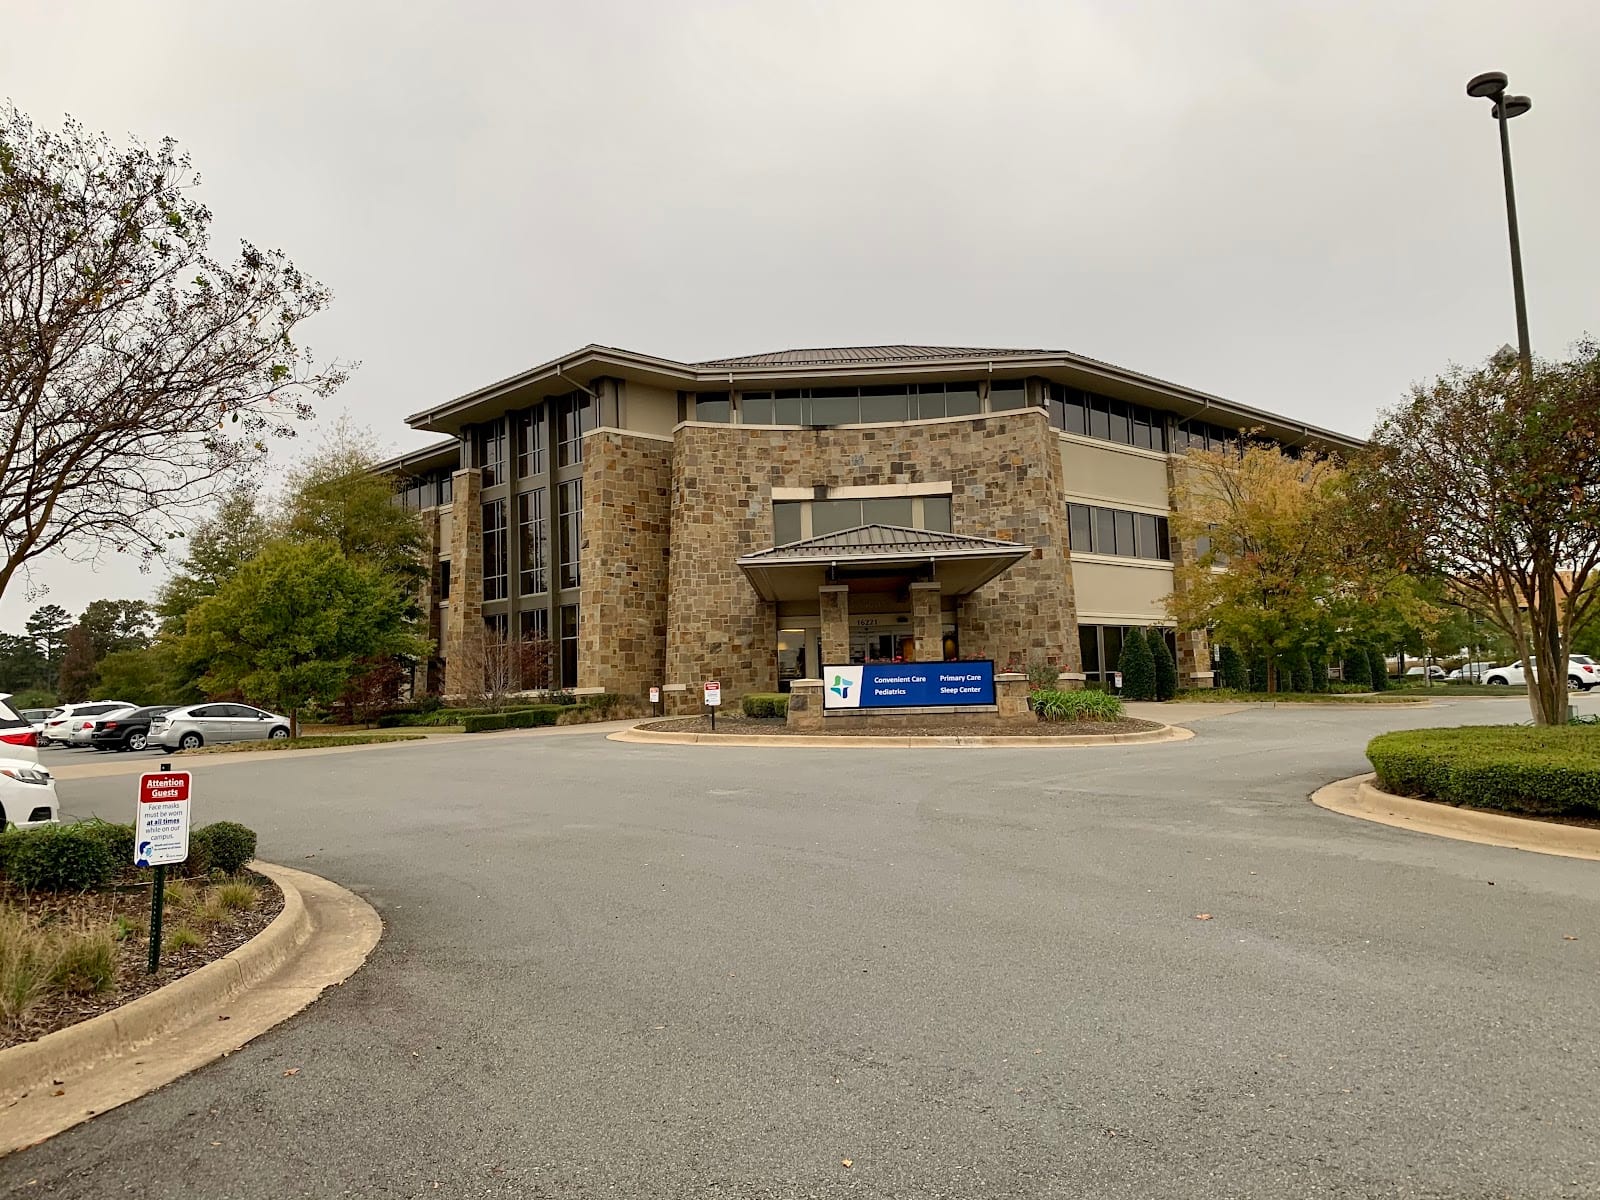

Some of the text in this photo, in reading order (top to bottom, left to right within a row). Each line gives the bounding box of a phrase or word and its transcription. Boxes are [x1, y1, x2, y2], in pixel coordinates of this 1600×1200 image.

[874, 675, 926, 684] Convenient Care
[940, 674, 965, 683] Primary
[874, 688, 906, 696] Pediatrics
[940, 686, 958, 694] Sleep
[147, 779, 184, 788] Attention
[152, 789, 178, 798] Guests
[154, 818, 162, 826] all
